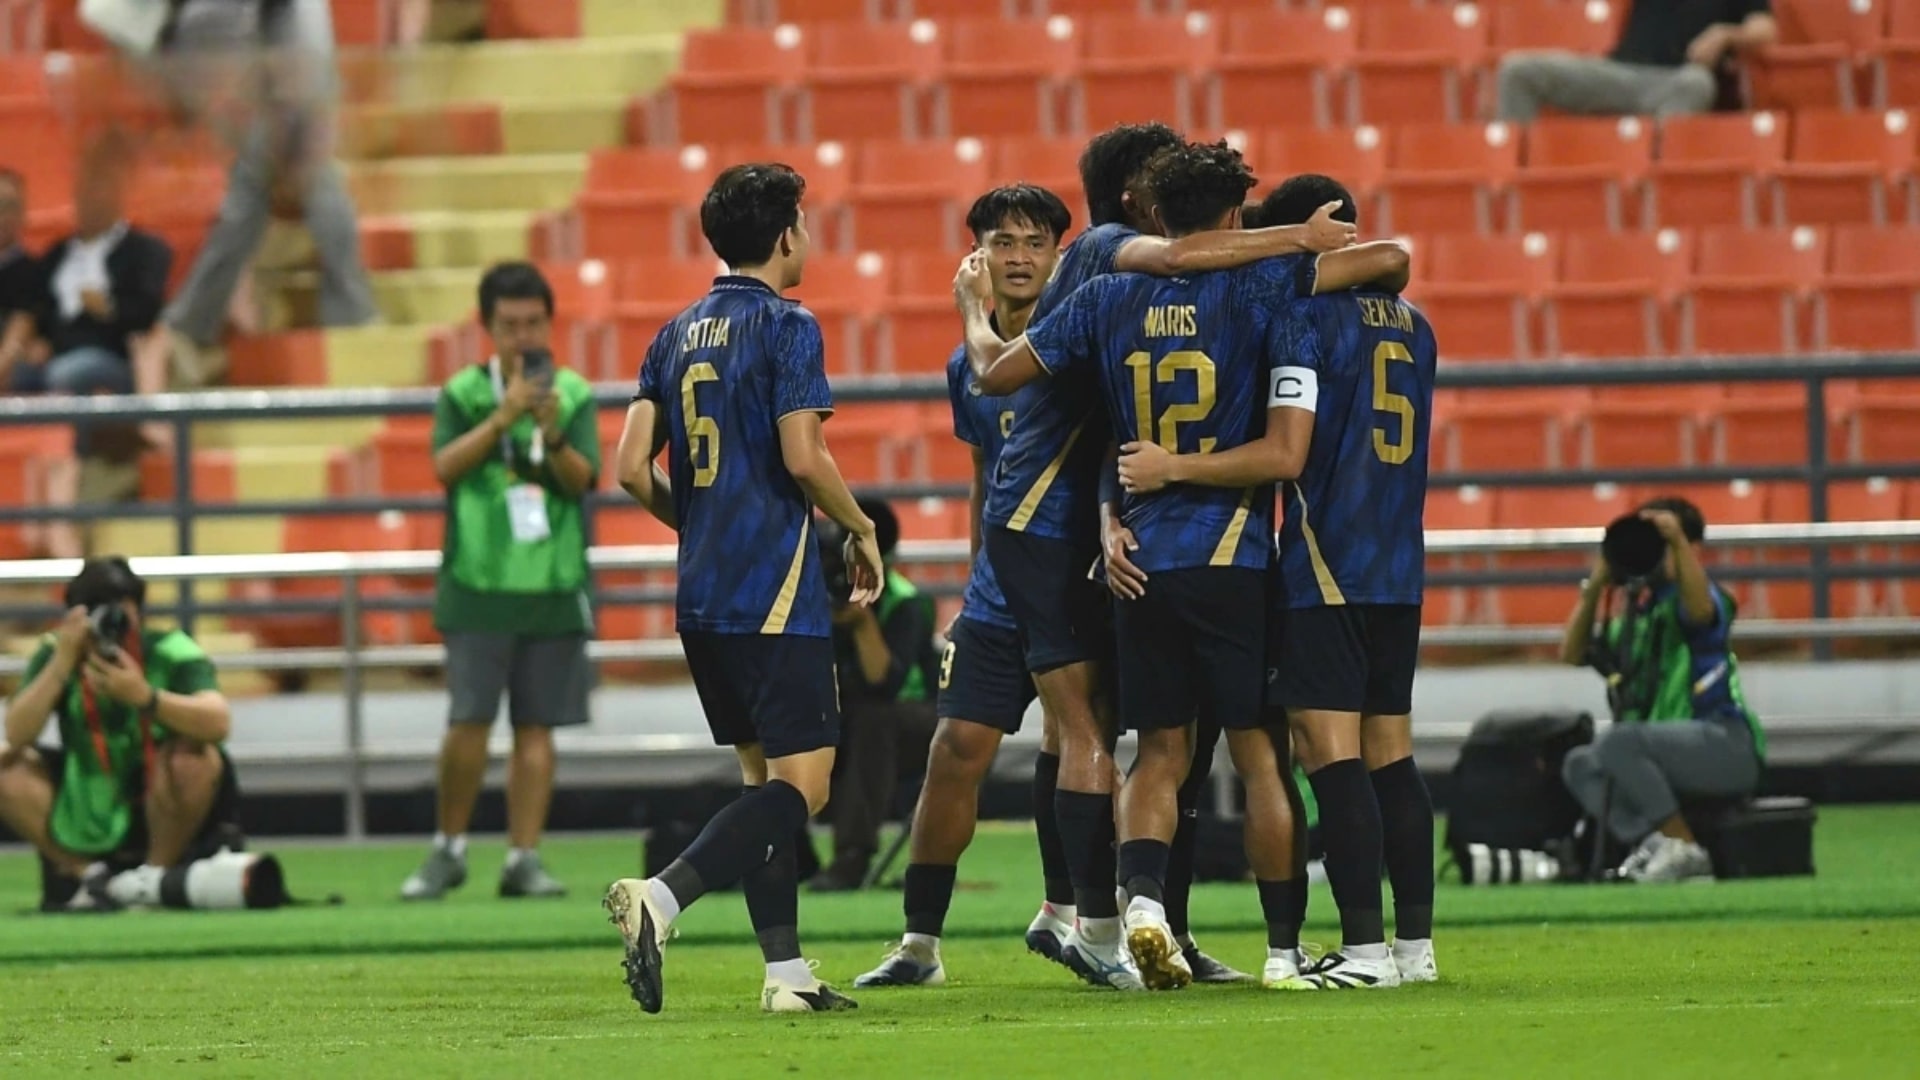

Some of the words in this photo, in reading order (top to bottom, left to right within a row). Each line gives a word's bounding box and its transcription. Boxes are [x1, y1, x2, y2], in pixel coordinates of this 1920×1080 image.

[683, 316, 730, 352] SITHA
[1144, 304, 1197, 338] WARIS
[1356, 297, 1413, 333] SEKSAN
[1124, 350, 1217, 455] 12
[1275, 377, 1302, 398] C
[1373, 340, 1415, 464] 5
[681, 362, 720, 487] 6
[938, 641, 956, 689] 9
